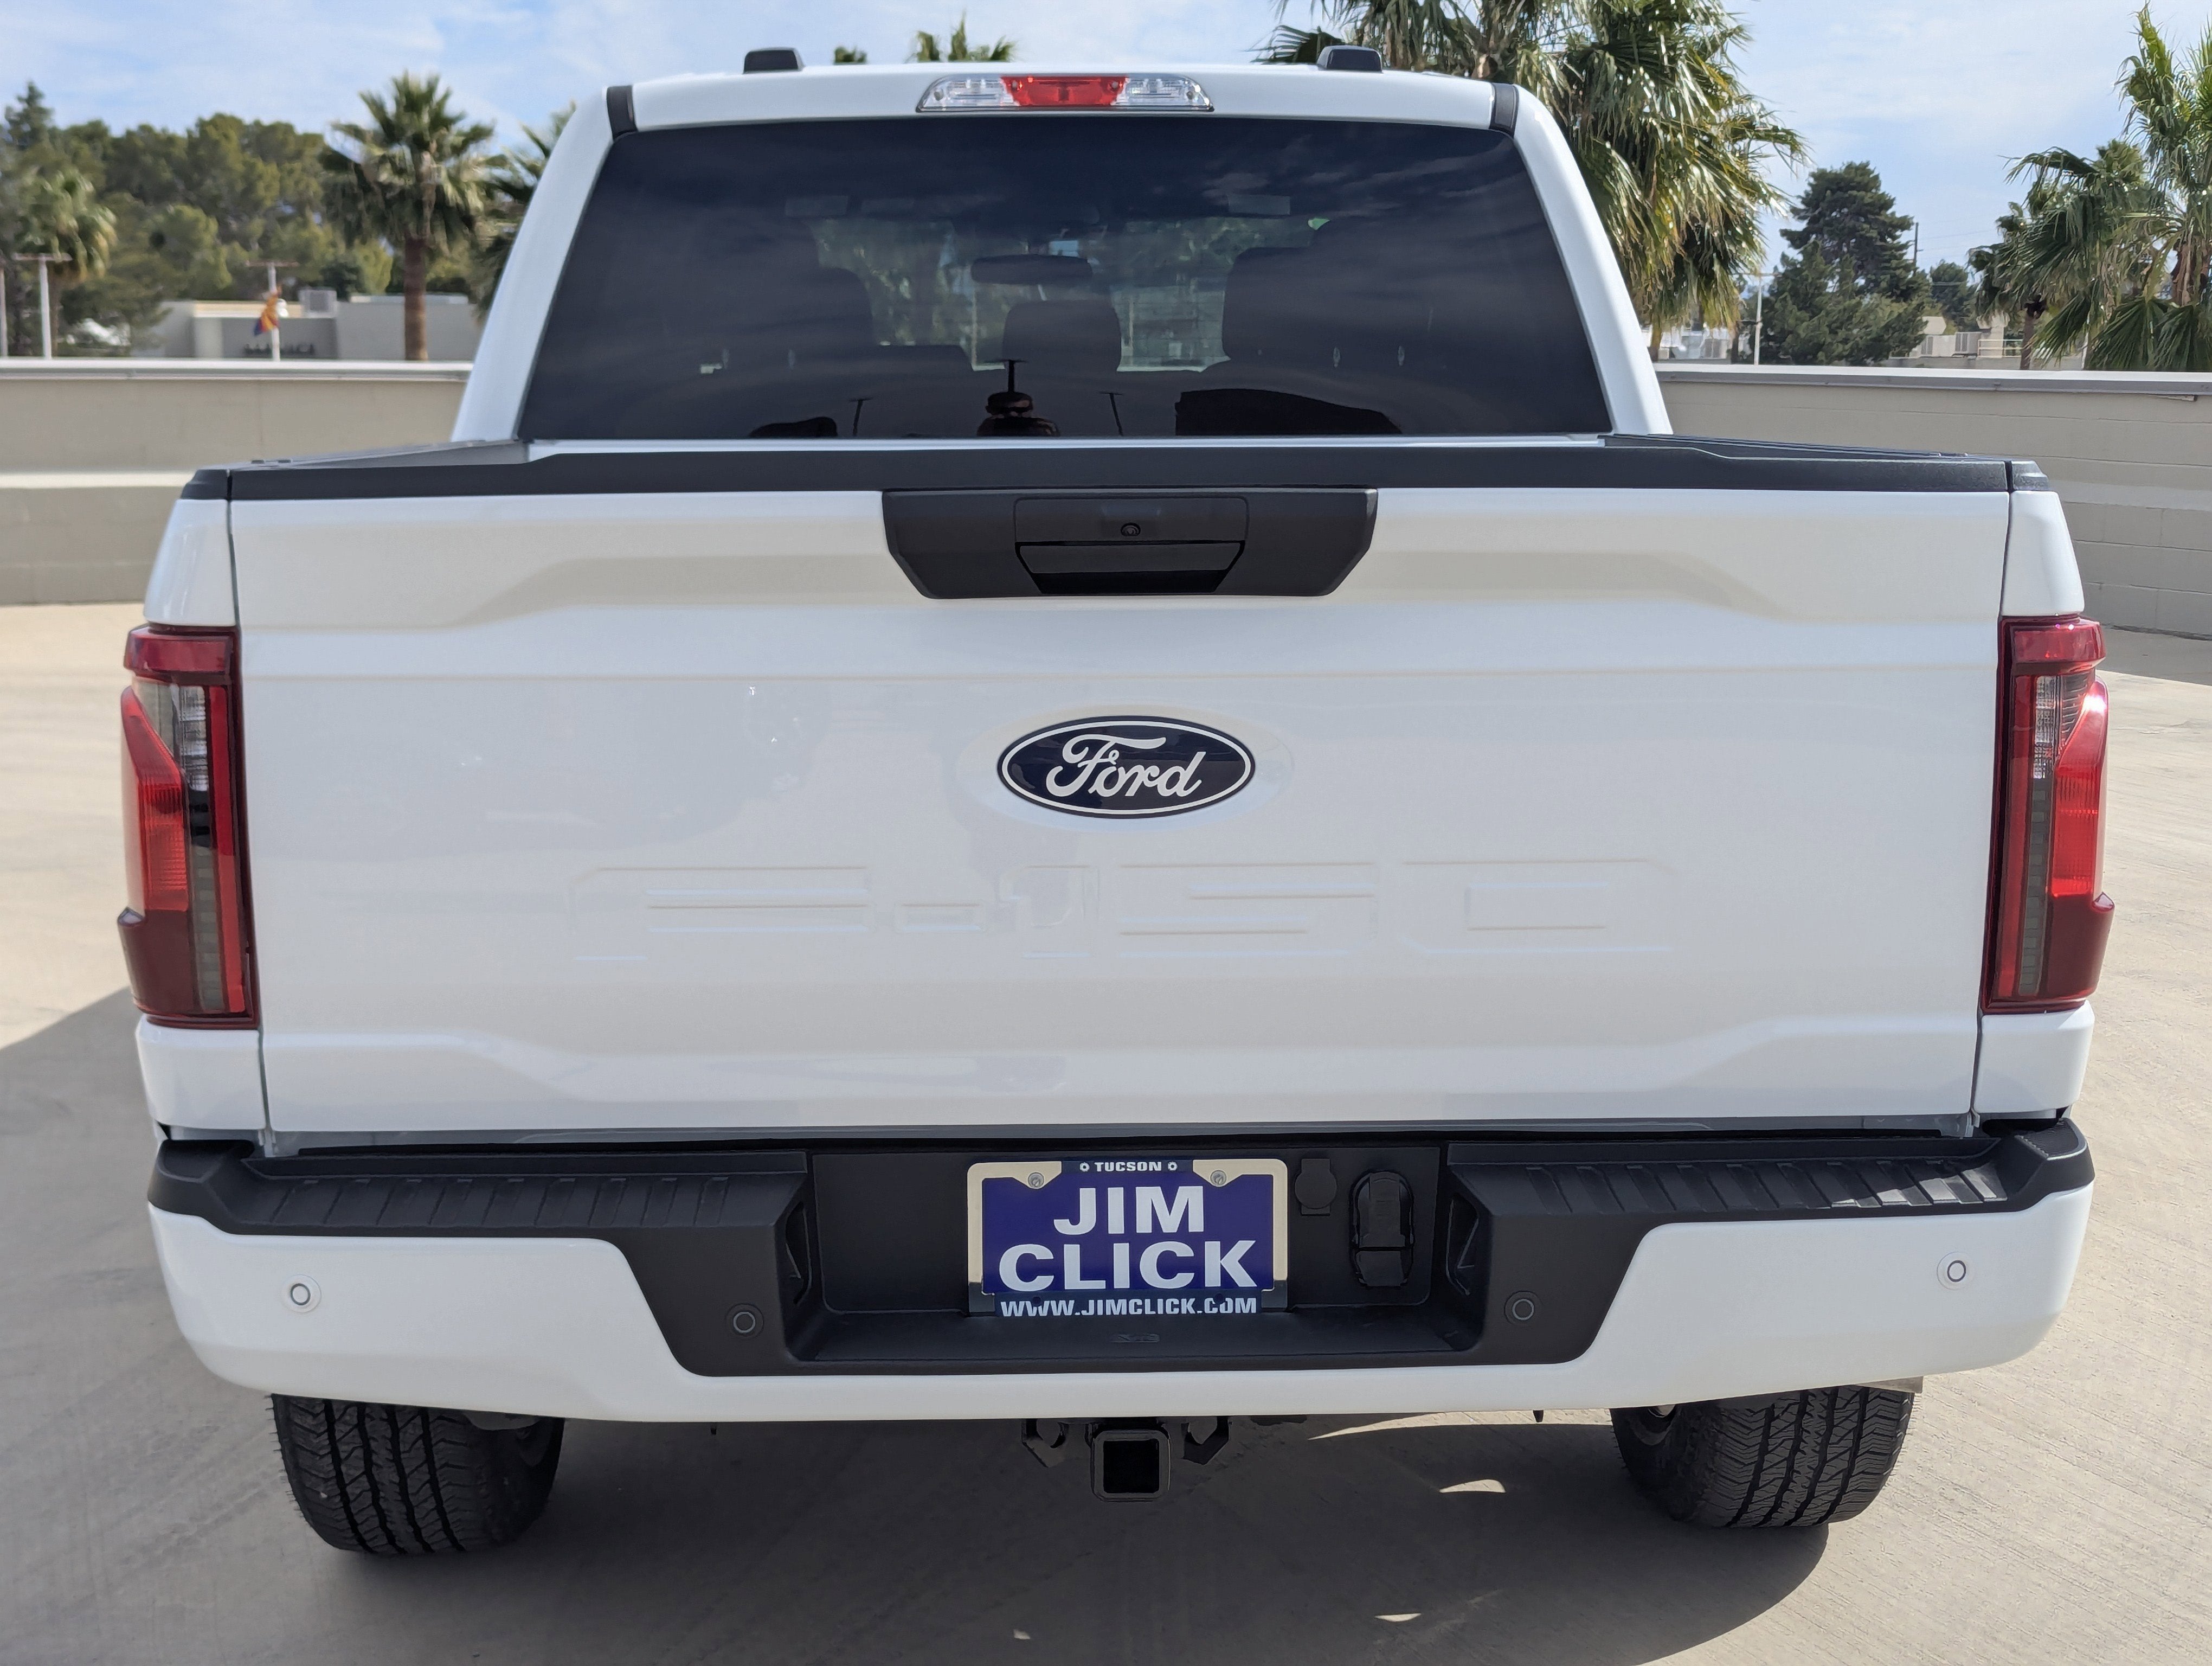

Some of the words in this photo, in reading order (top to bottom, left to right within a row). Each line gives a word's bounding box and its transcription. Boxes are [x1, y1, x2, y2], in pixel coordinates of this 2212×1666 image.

[1046, 734, 1206, 797] Ford
[567, 859, 1676, 961] F-150
[1094, 1162, 1162, 1172] TUCSON
[1053, 1186, 1204, 1235] JIM
[999, 1240, 1257, 1291] CLICK
[1000, 1298, 1256, 1317] WWW.JIMCLICK.COM
